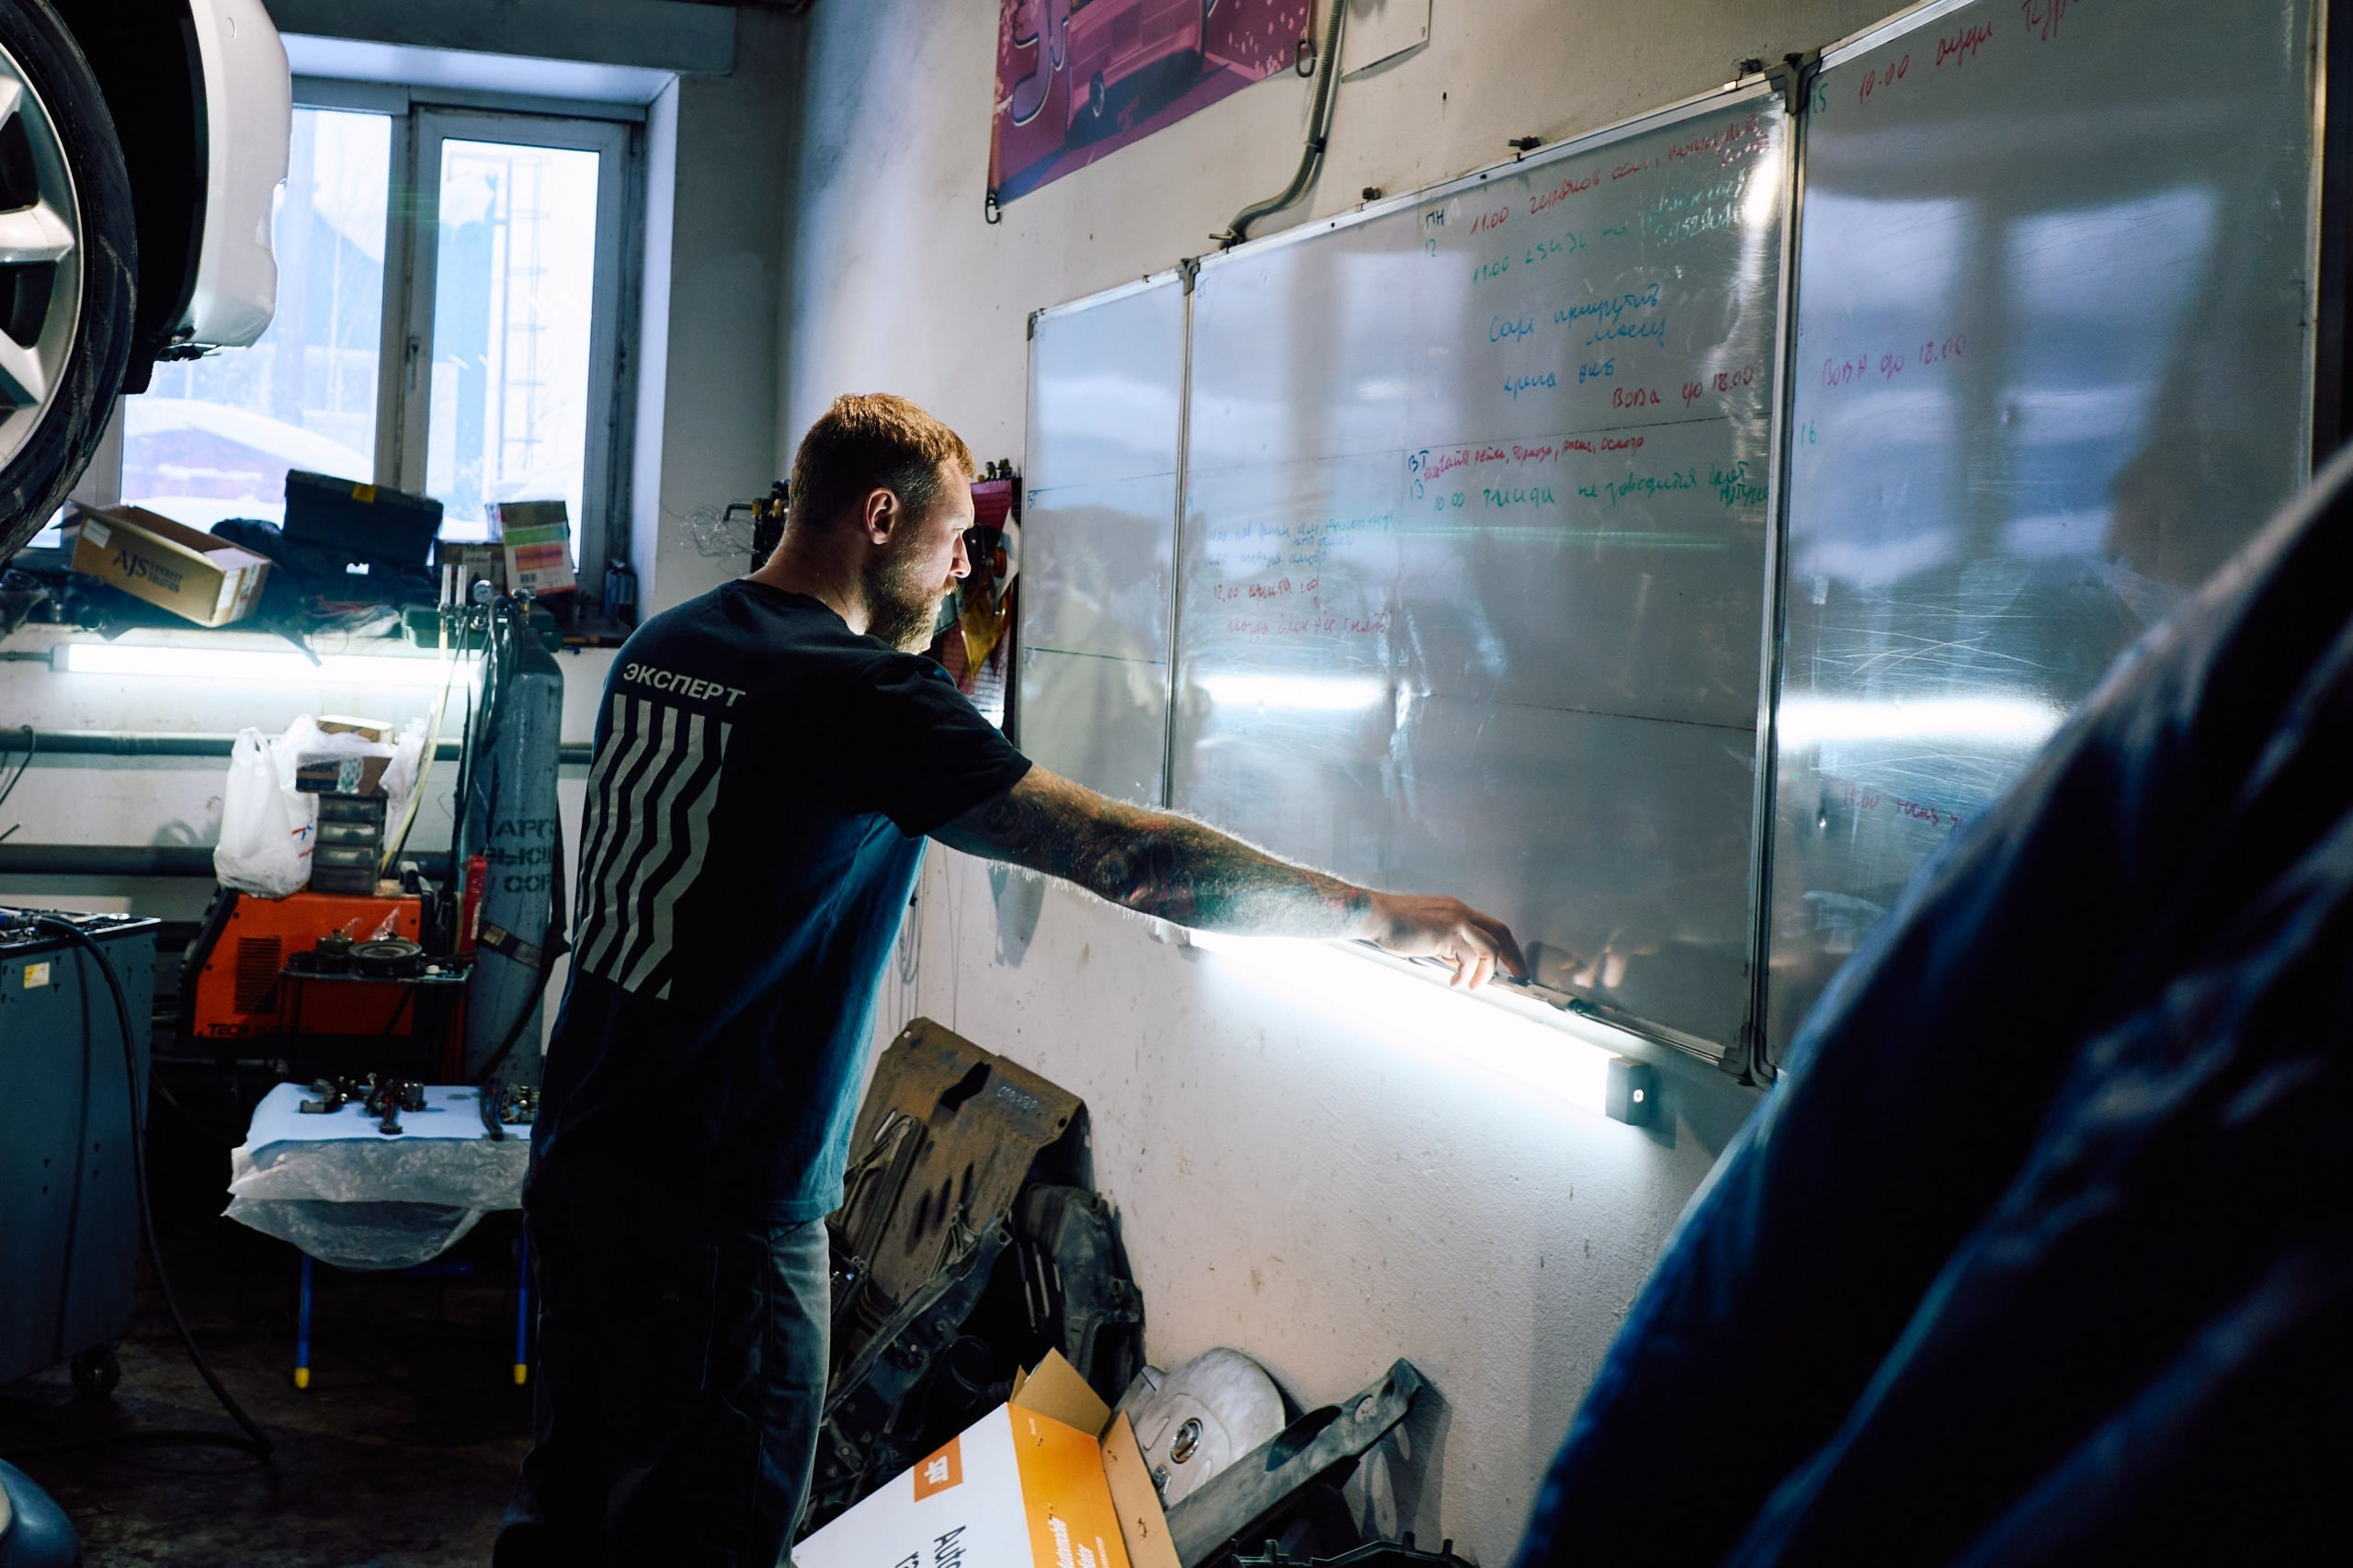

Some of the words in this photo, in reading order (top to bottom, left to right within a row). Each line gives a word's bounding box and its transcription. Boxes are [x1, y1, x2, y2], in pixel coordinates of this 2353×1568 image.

[1859, 53, 1909, 104] 10.00
[1812, 83, 1829, 114] 15
[1471, 206, 1509, 235] 11.00
[112, 550, 150, 577] AJS
[622, 663, 746, 708] ЭКСПЕРТ
